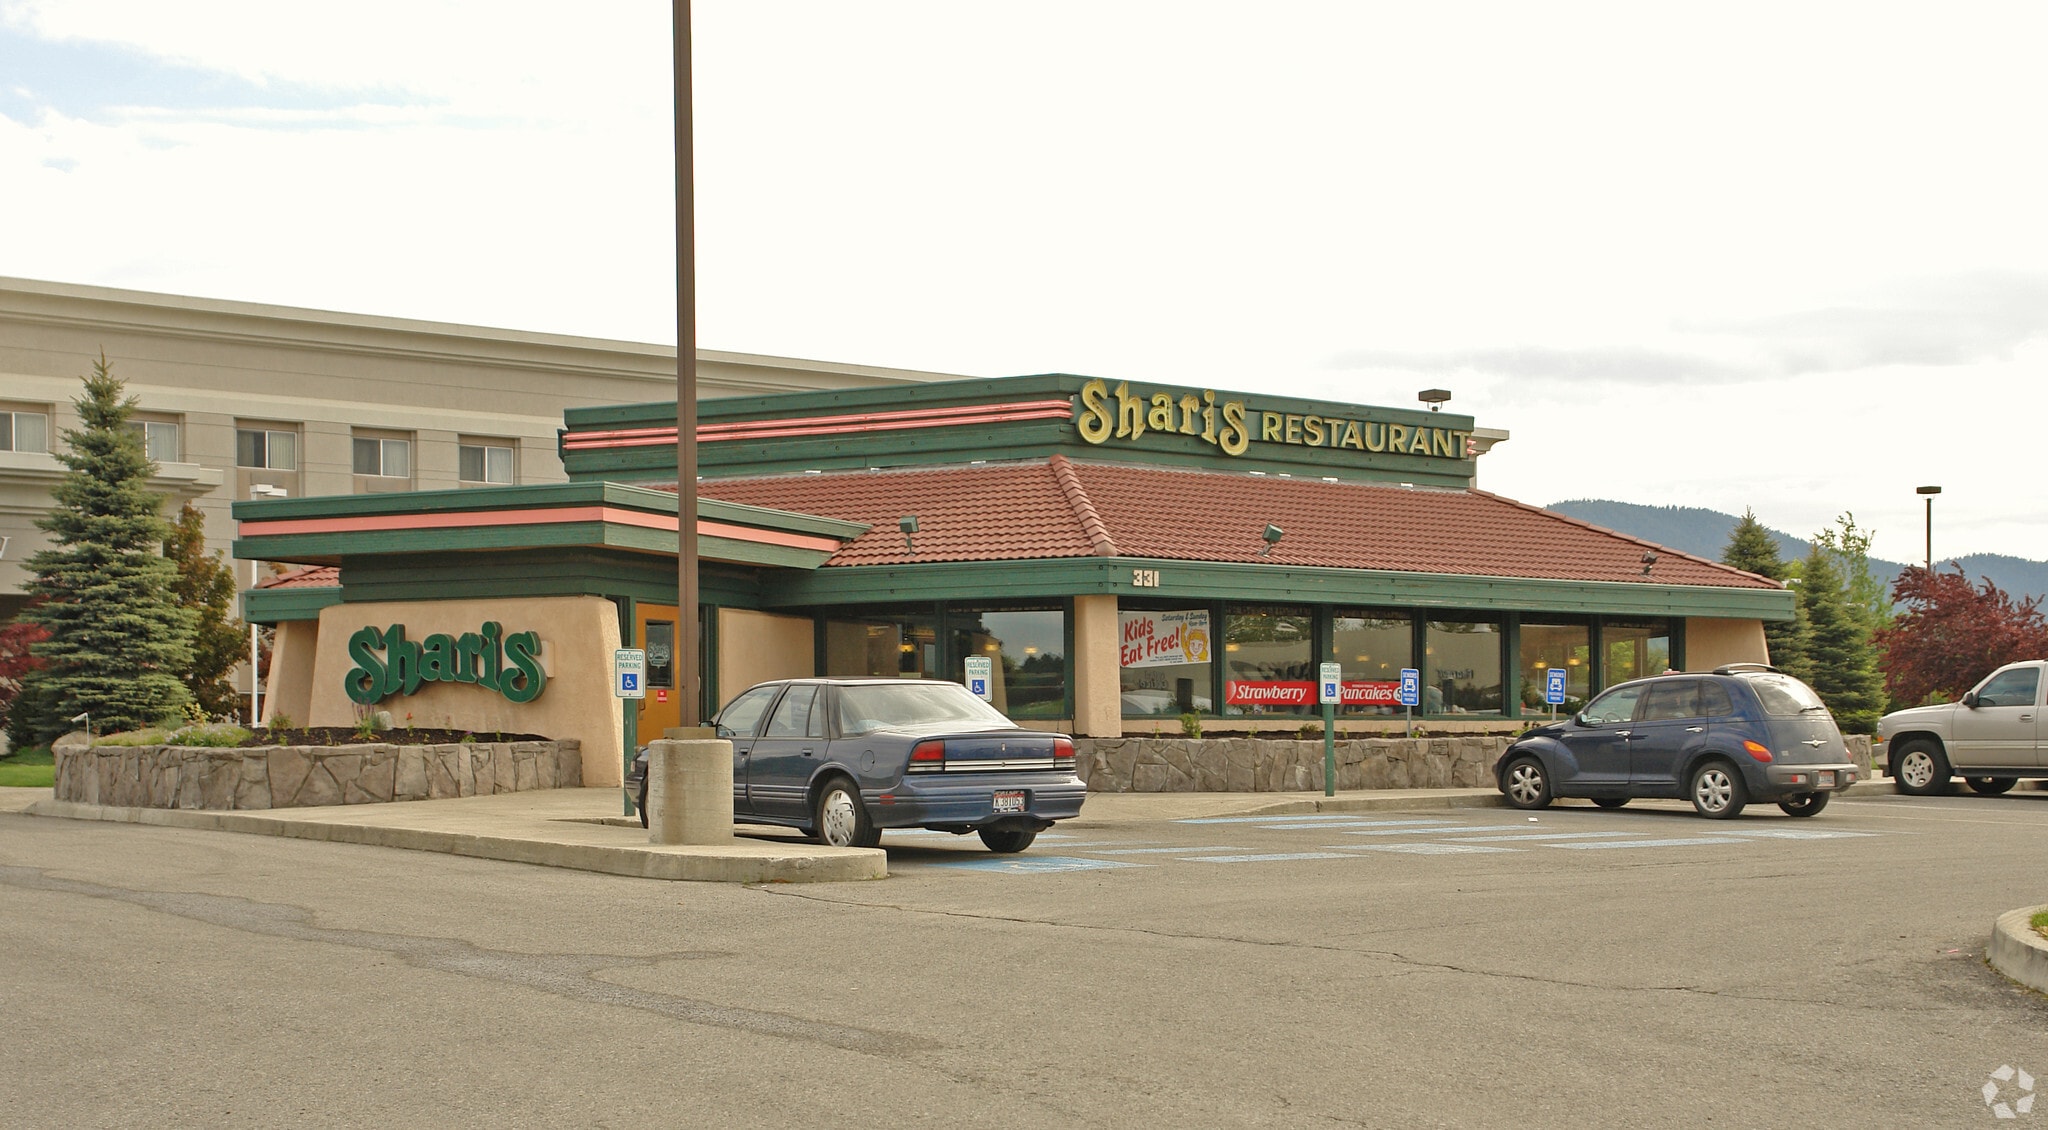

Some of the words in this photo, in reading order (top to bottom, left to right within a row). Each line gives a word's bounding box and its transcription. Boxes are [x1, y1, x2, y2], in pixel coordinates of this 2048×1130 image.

[1262, 412, 1471, 458] RESTAURANT
[1133, 570, 1159, 587] 331
[1124, 616, 1154, 643] Kids
[1120, 643, 1143, 667] Eat
[1147, 627, 1179, 657] Free!
[1236, 685, 1306, 702] Strawberry
[1339, 686, 1392, 700] Pancakes
